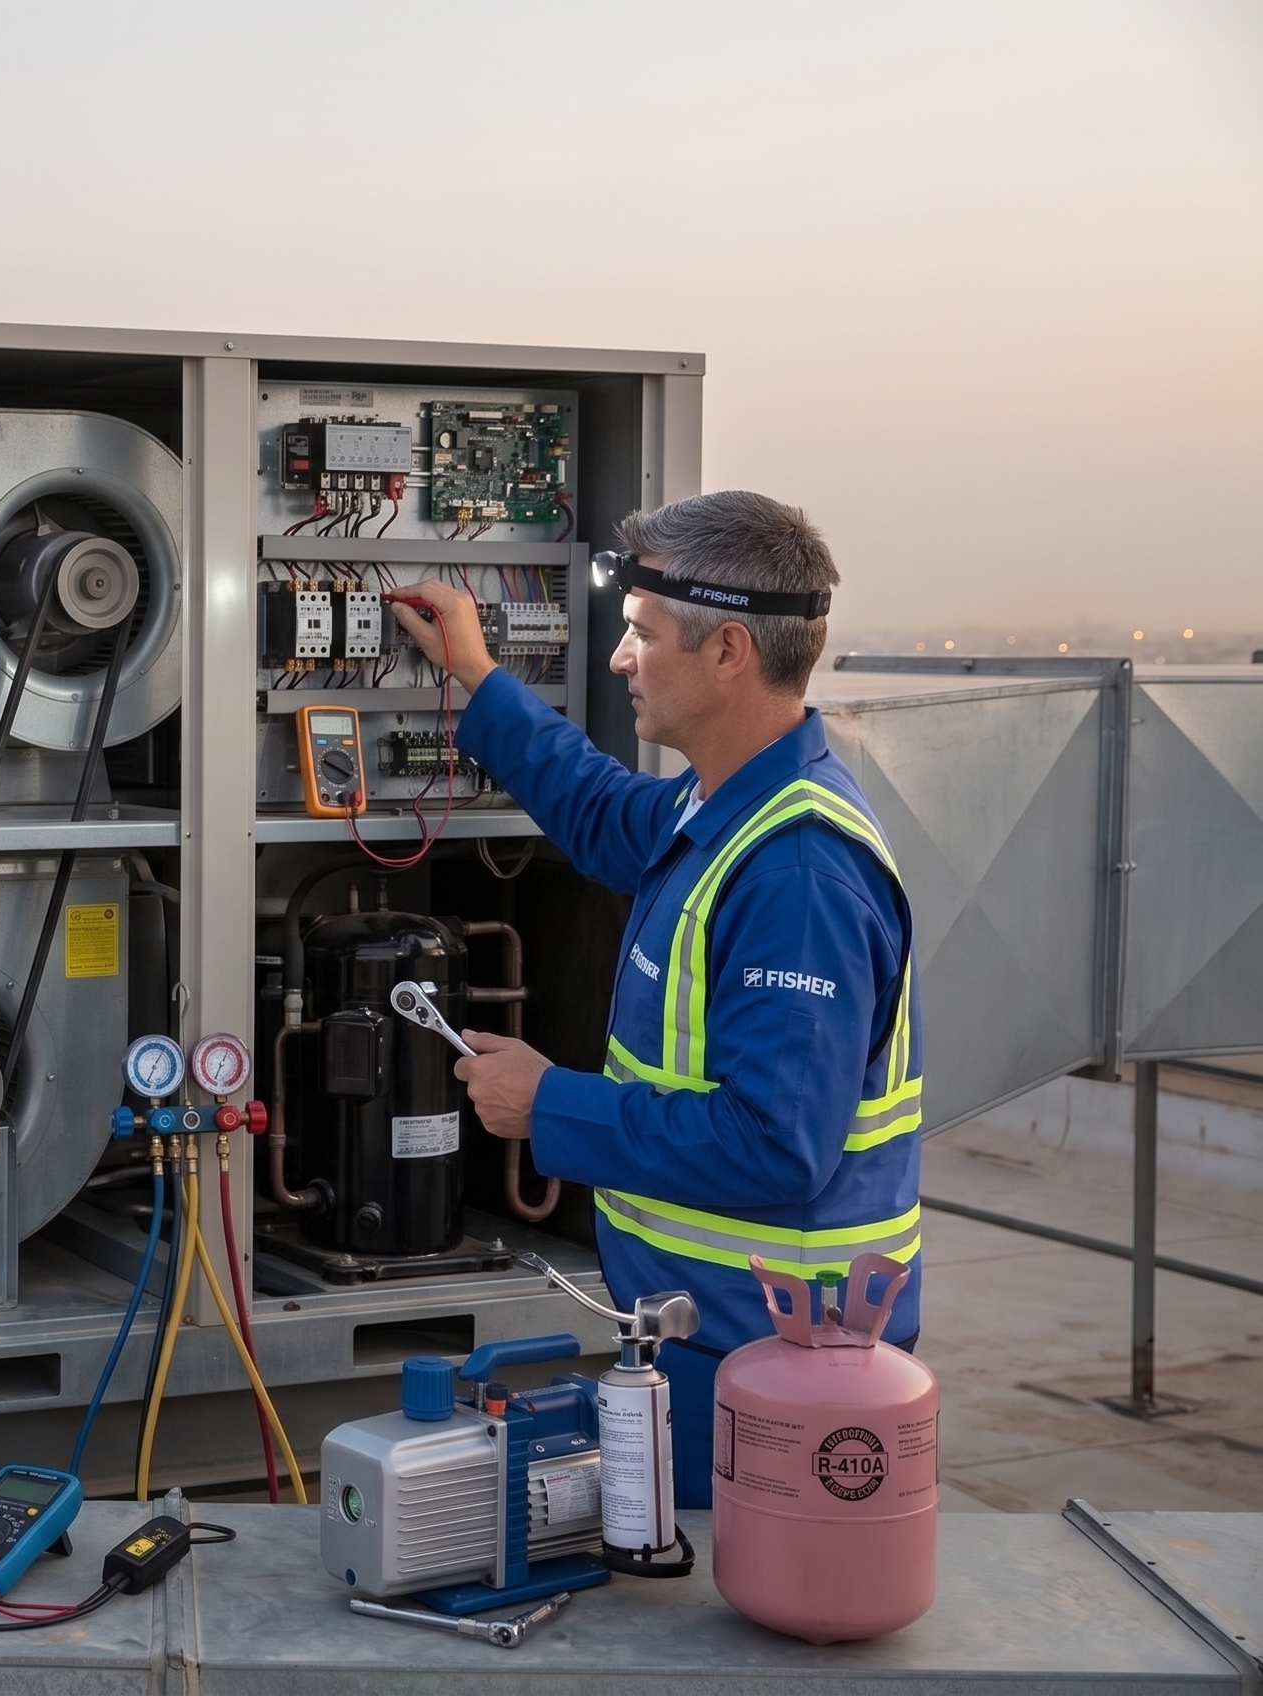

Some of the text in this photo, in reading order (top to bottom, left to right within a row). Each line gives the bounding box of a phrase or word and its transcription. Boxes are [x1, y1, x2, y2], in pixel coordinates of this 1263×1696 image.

[702, 588, 749, 606] FISHER
[765, 970, 836, 998] FISHER
[818, 1457, 884, 1474] R-410A
